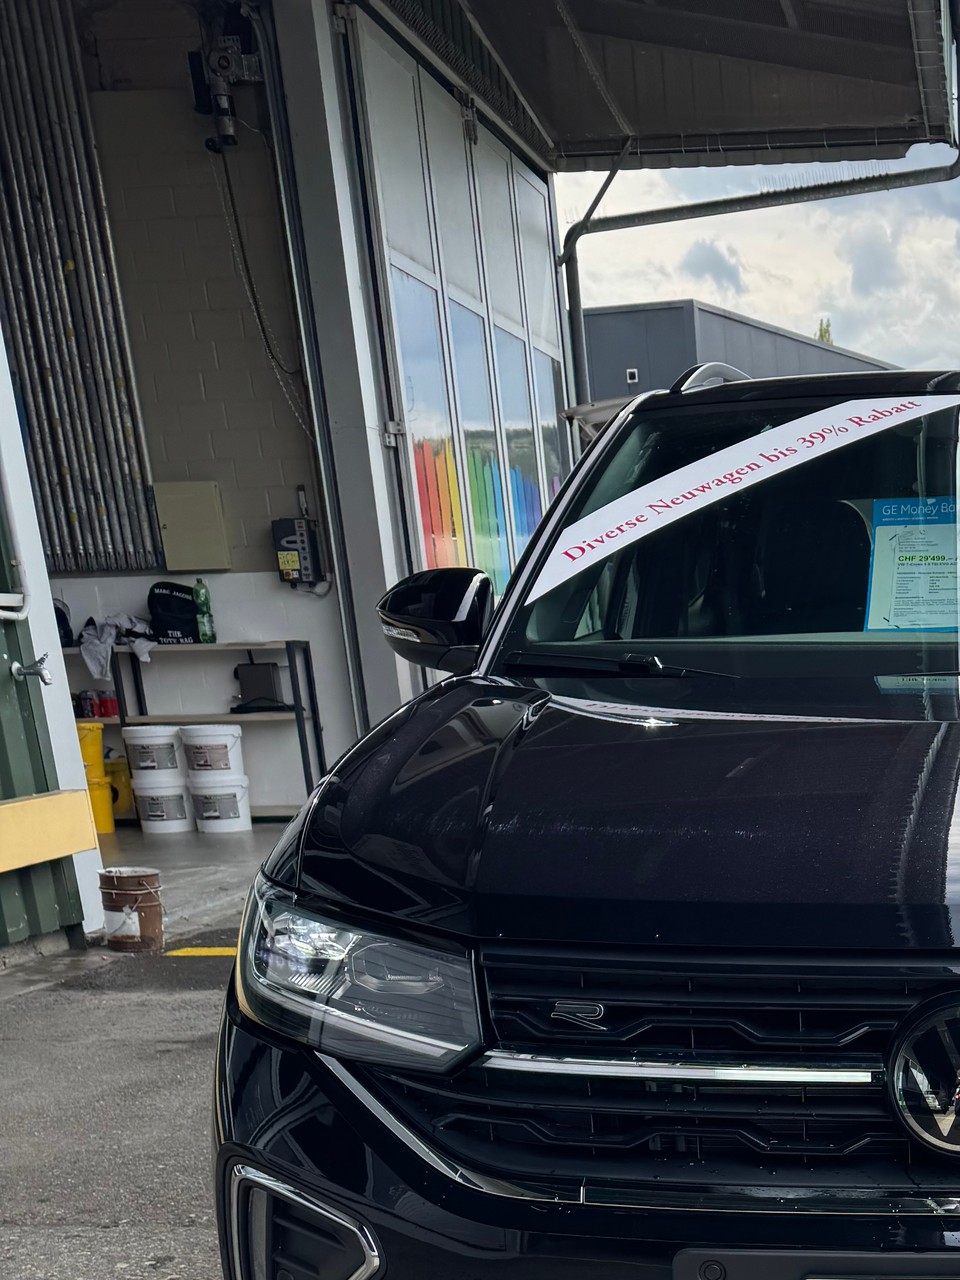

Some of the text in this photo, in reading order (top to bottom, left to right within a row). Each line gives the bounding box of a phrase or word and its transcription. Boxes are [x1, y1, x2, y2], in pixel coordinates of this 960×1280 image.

[561, 399, 923, 563] Diverse Neuwagen bis 39% Rabatt
[882, 504, 898, 516] GE
[900, 503, 939, 516] Money
